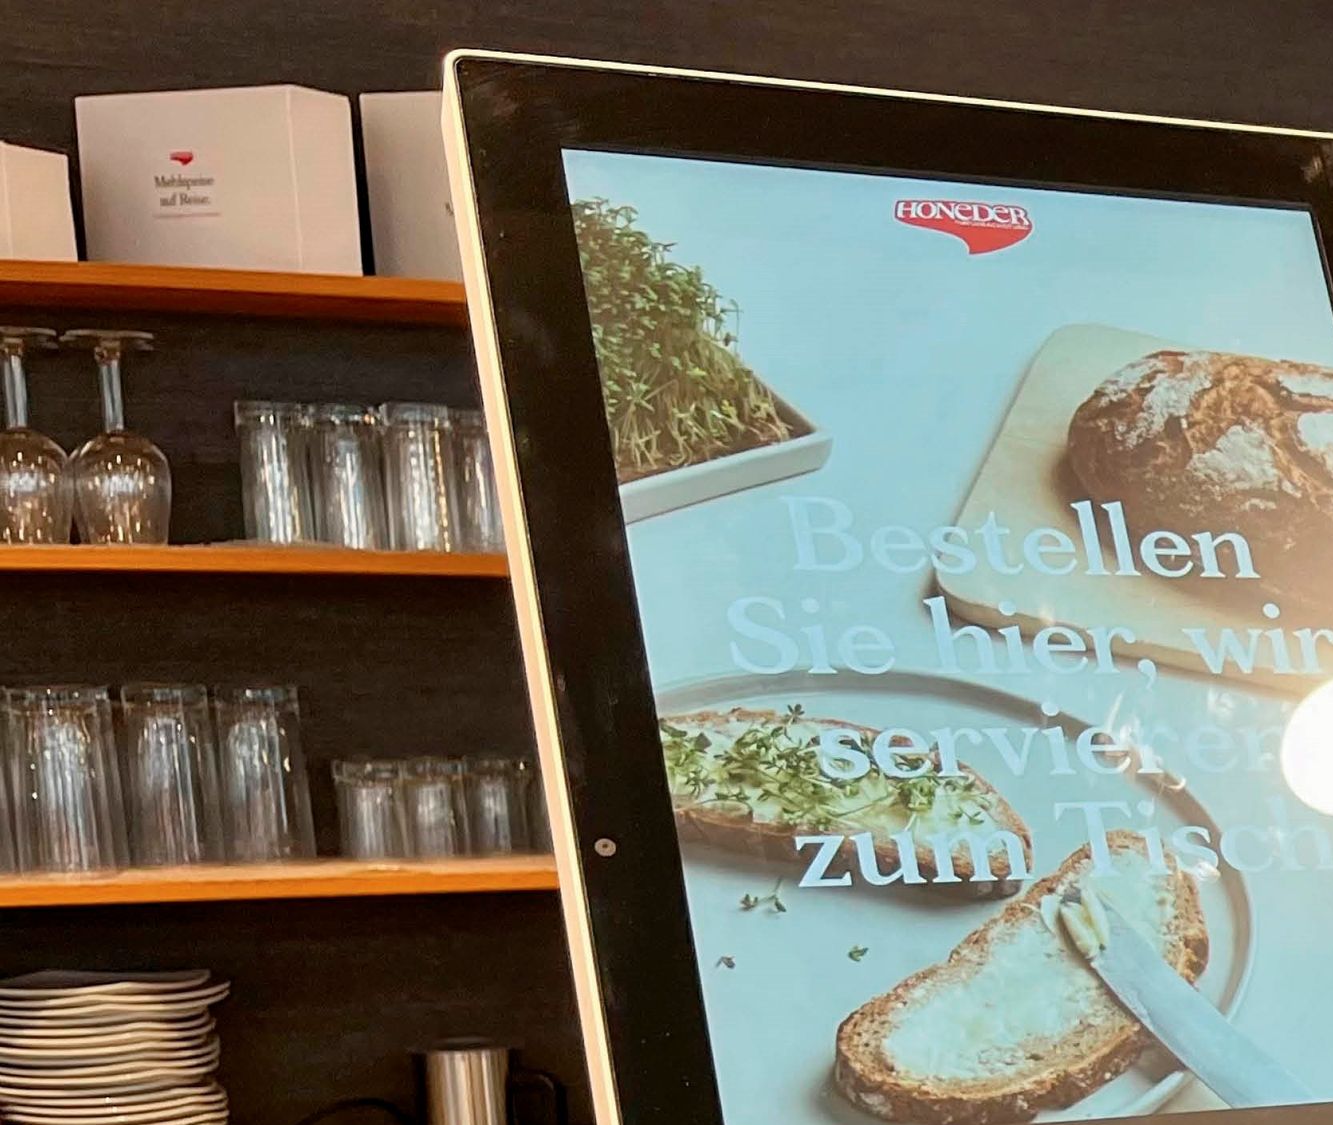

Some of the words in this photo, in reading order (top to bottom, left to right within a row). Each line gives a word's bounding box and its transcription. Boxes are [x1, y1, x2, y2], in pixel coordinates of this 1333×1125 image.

[780, 496, 1261, 579] Bestellen
[726, 596, 896, 676] Sie
[924, 595, 1158, 690] hier,
[795, 824, 1034, 889] zum
